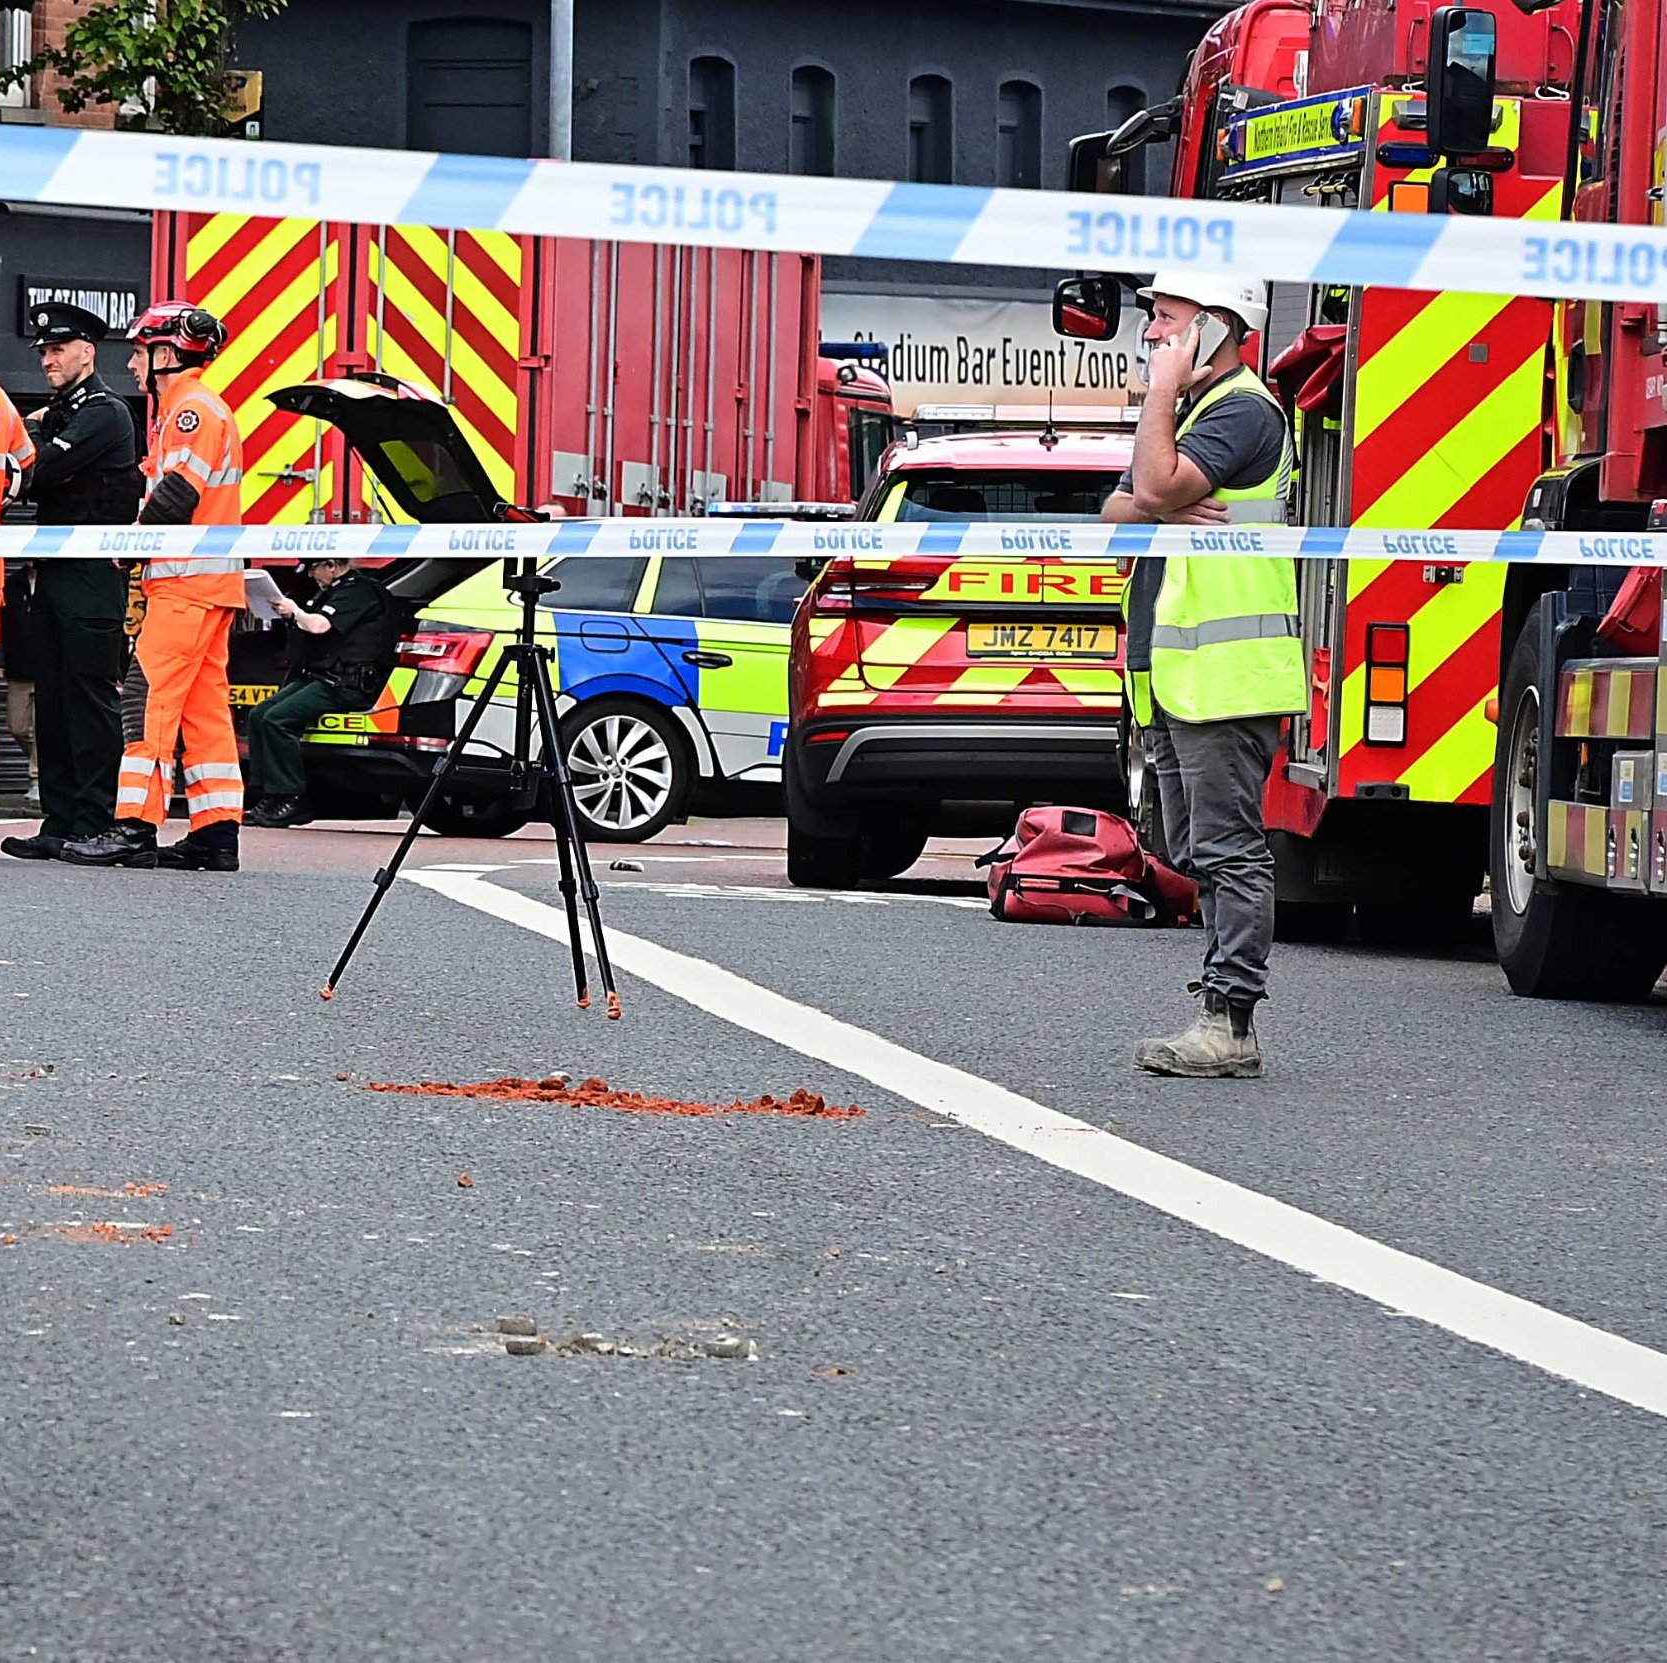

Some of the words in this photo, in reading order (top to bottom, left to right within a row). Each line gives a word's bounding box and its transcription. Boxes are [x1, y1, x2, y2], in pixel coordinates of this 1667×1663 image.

[109, 292, 136, 329] BAR
[957, 337, 996, 386] Bar
[1003, 338, 1067, 387] Event
[1073, 341, 1128, 389] Zone
[949, 572, 1125, 596] FIRE
[983, 625, 1034, 647] JMZ
[1042, 626, 1100, 649] 7417
